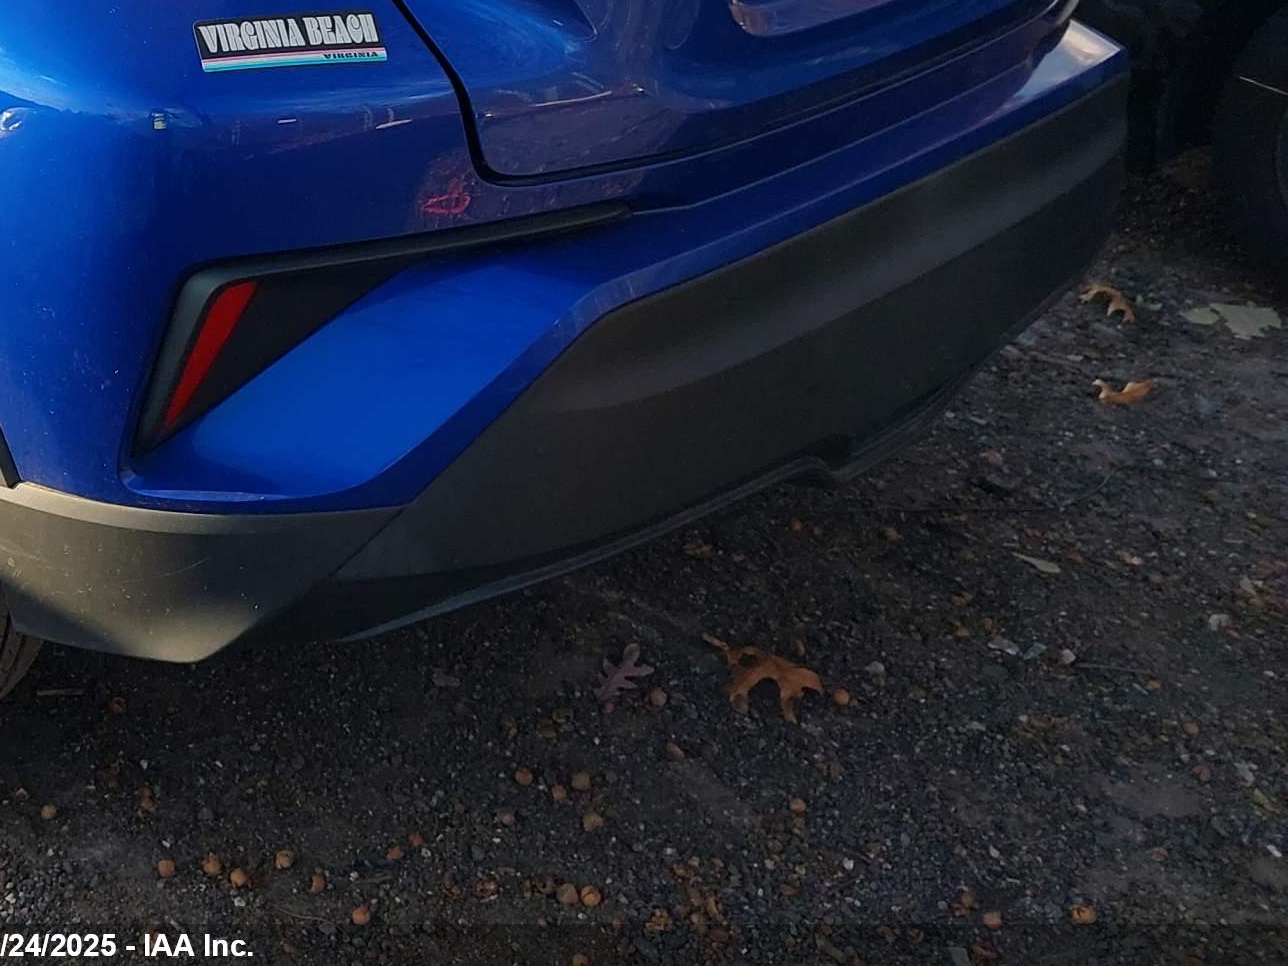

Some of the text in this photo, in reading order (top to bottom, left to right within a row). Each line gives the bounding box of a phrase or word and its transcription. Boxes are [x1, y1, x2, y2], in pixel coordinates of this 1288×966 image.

[199, 13, 379, 54] VIRGINIA BEACH
[322, 51, 380, 60] VIRGINIA
